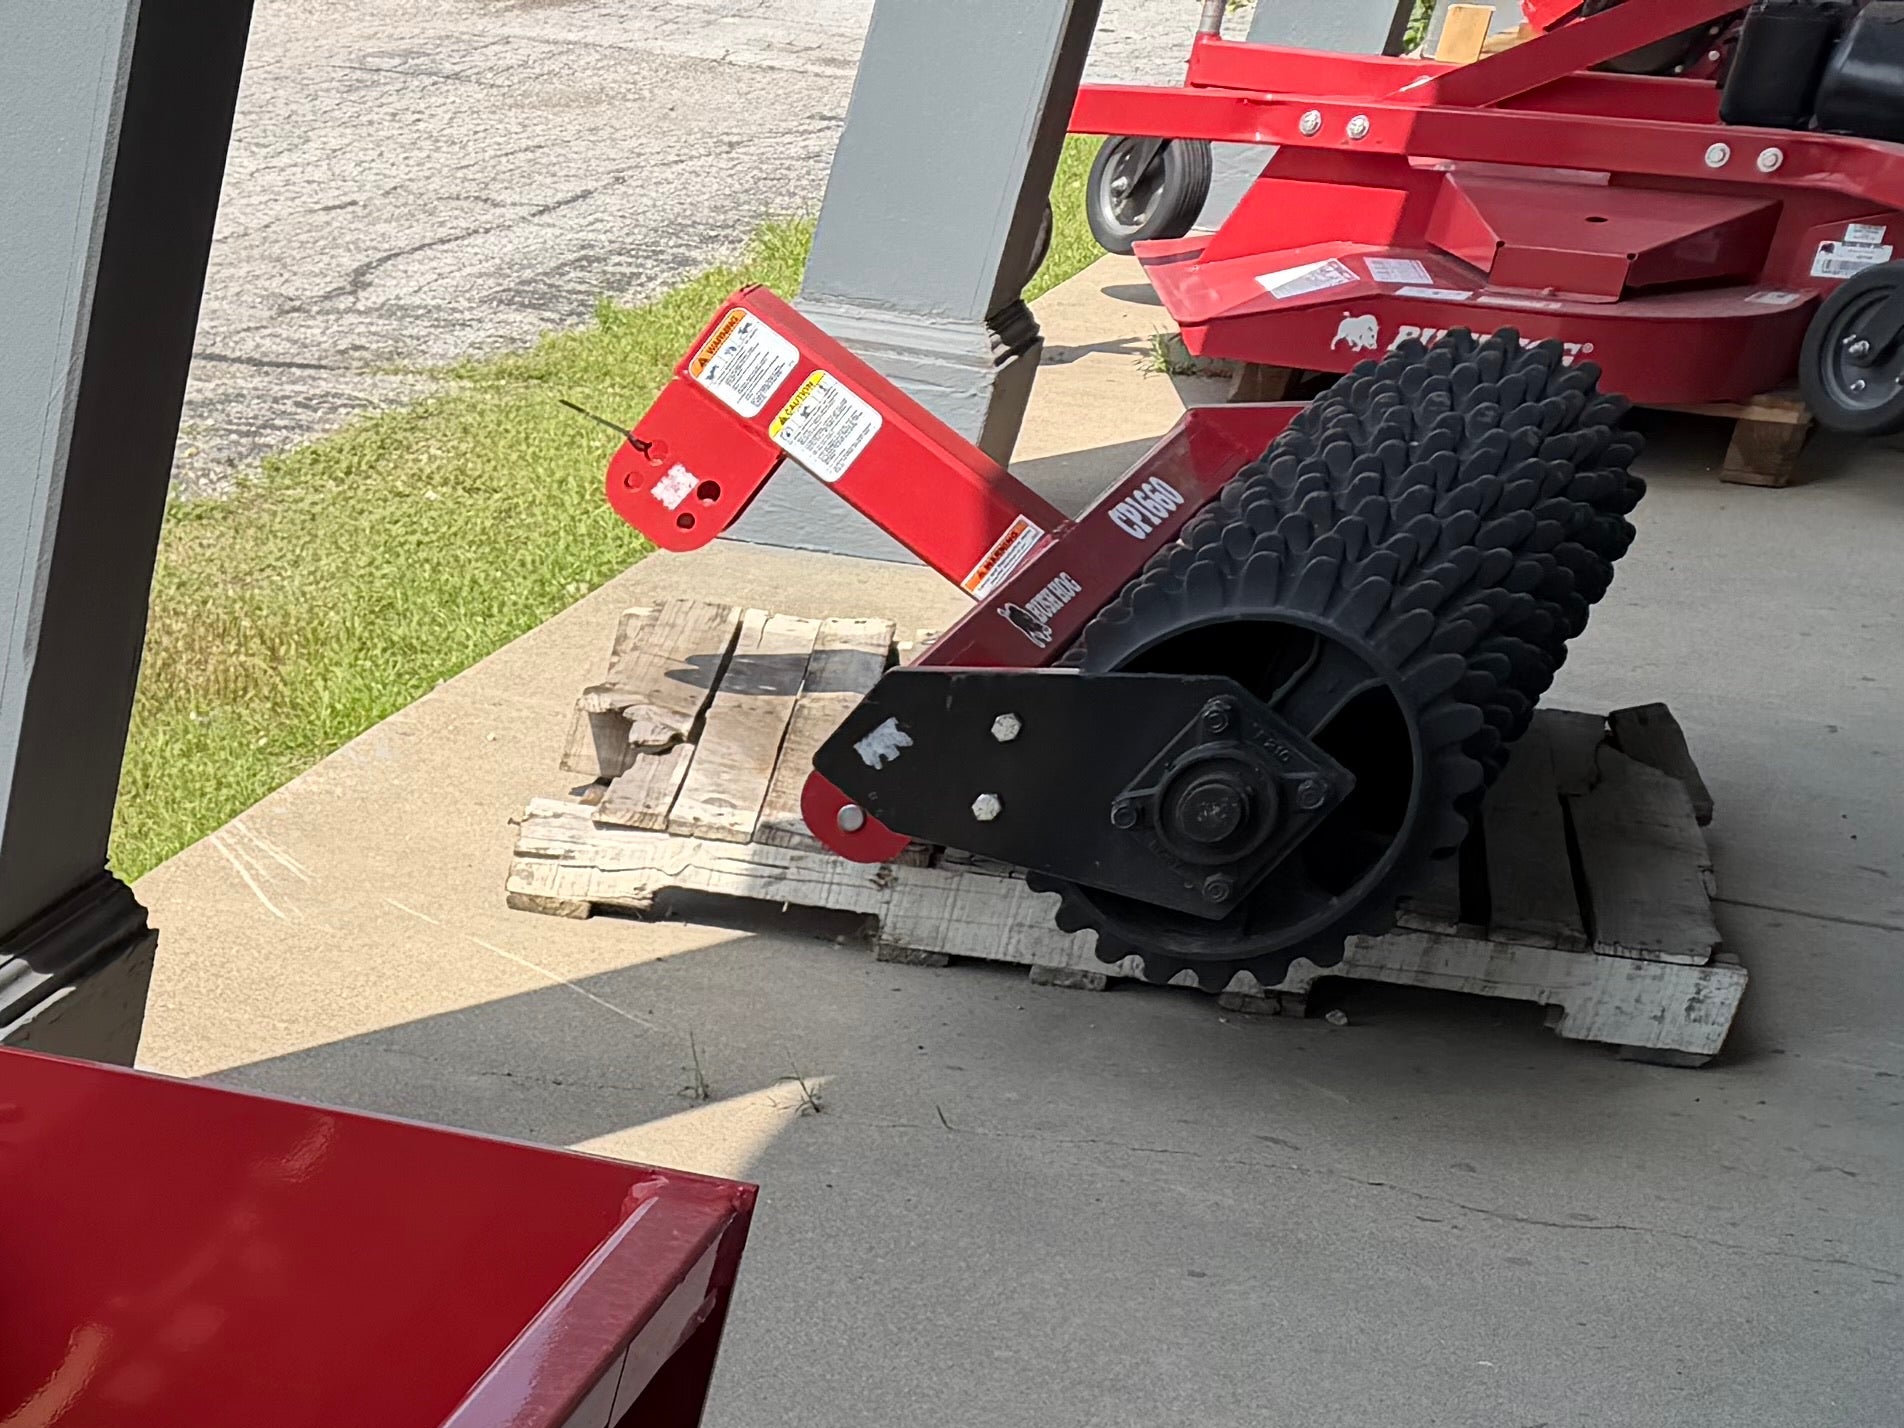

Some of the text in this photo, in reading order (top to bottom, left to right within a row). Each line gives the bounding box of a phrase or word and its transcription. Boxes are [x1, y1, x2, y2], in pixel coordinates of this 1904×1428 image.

[1108, 476, 1185, 540] CP1660
[1025, 571, 1082, 624] BUSH HOG
